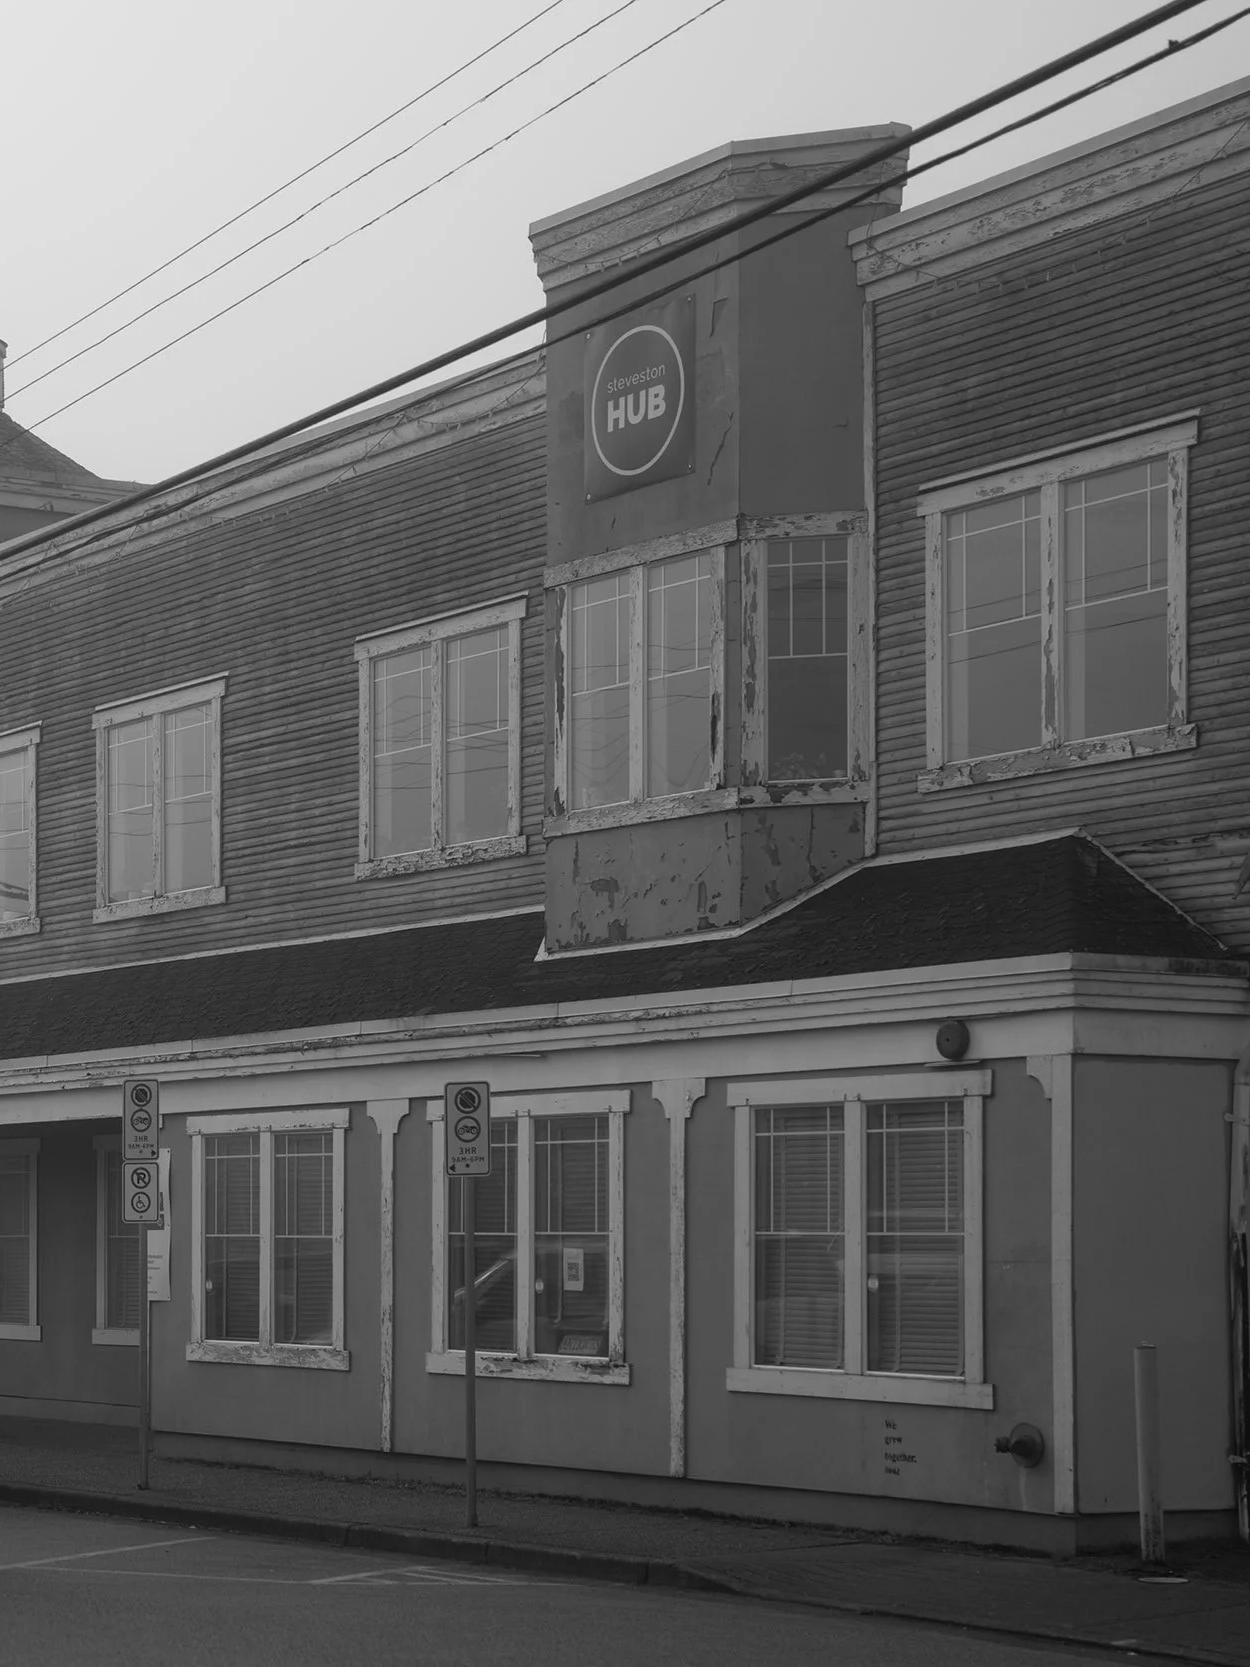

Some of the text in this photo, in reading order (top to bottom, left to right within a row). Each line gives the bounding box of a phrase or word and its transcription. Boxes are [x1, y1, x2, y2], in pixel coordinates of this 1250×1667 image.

[607, 364, 666, 393] steveston
[607, 384, 666, 432] HUB
[133, 1135, 149, 1143] 3HR
[459, 1147, 477, 1155] 3HR
